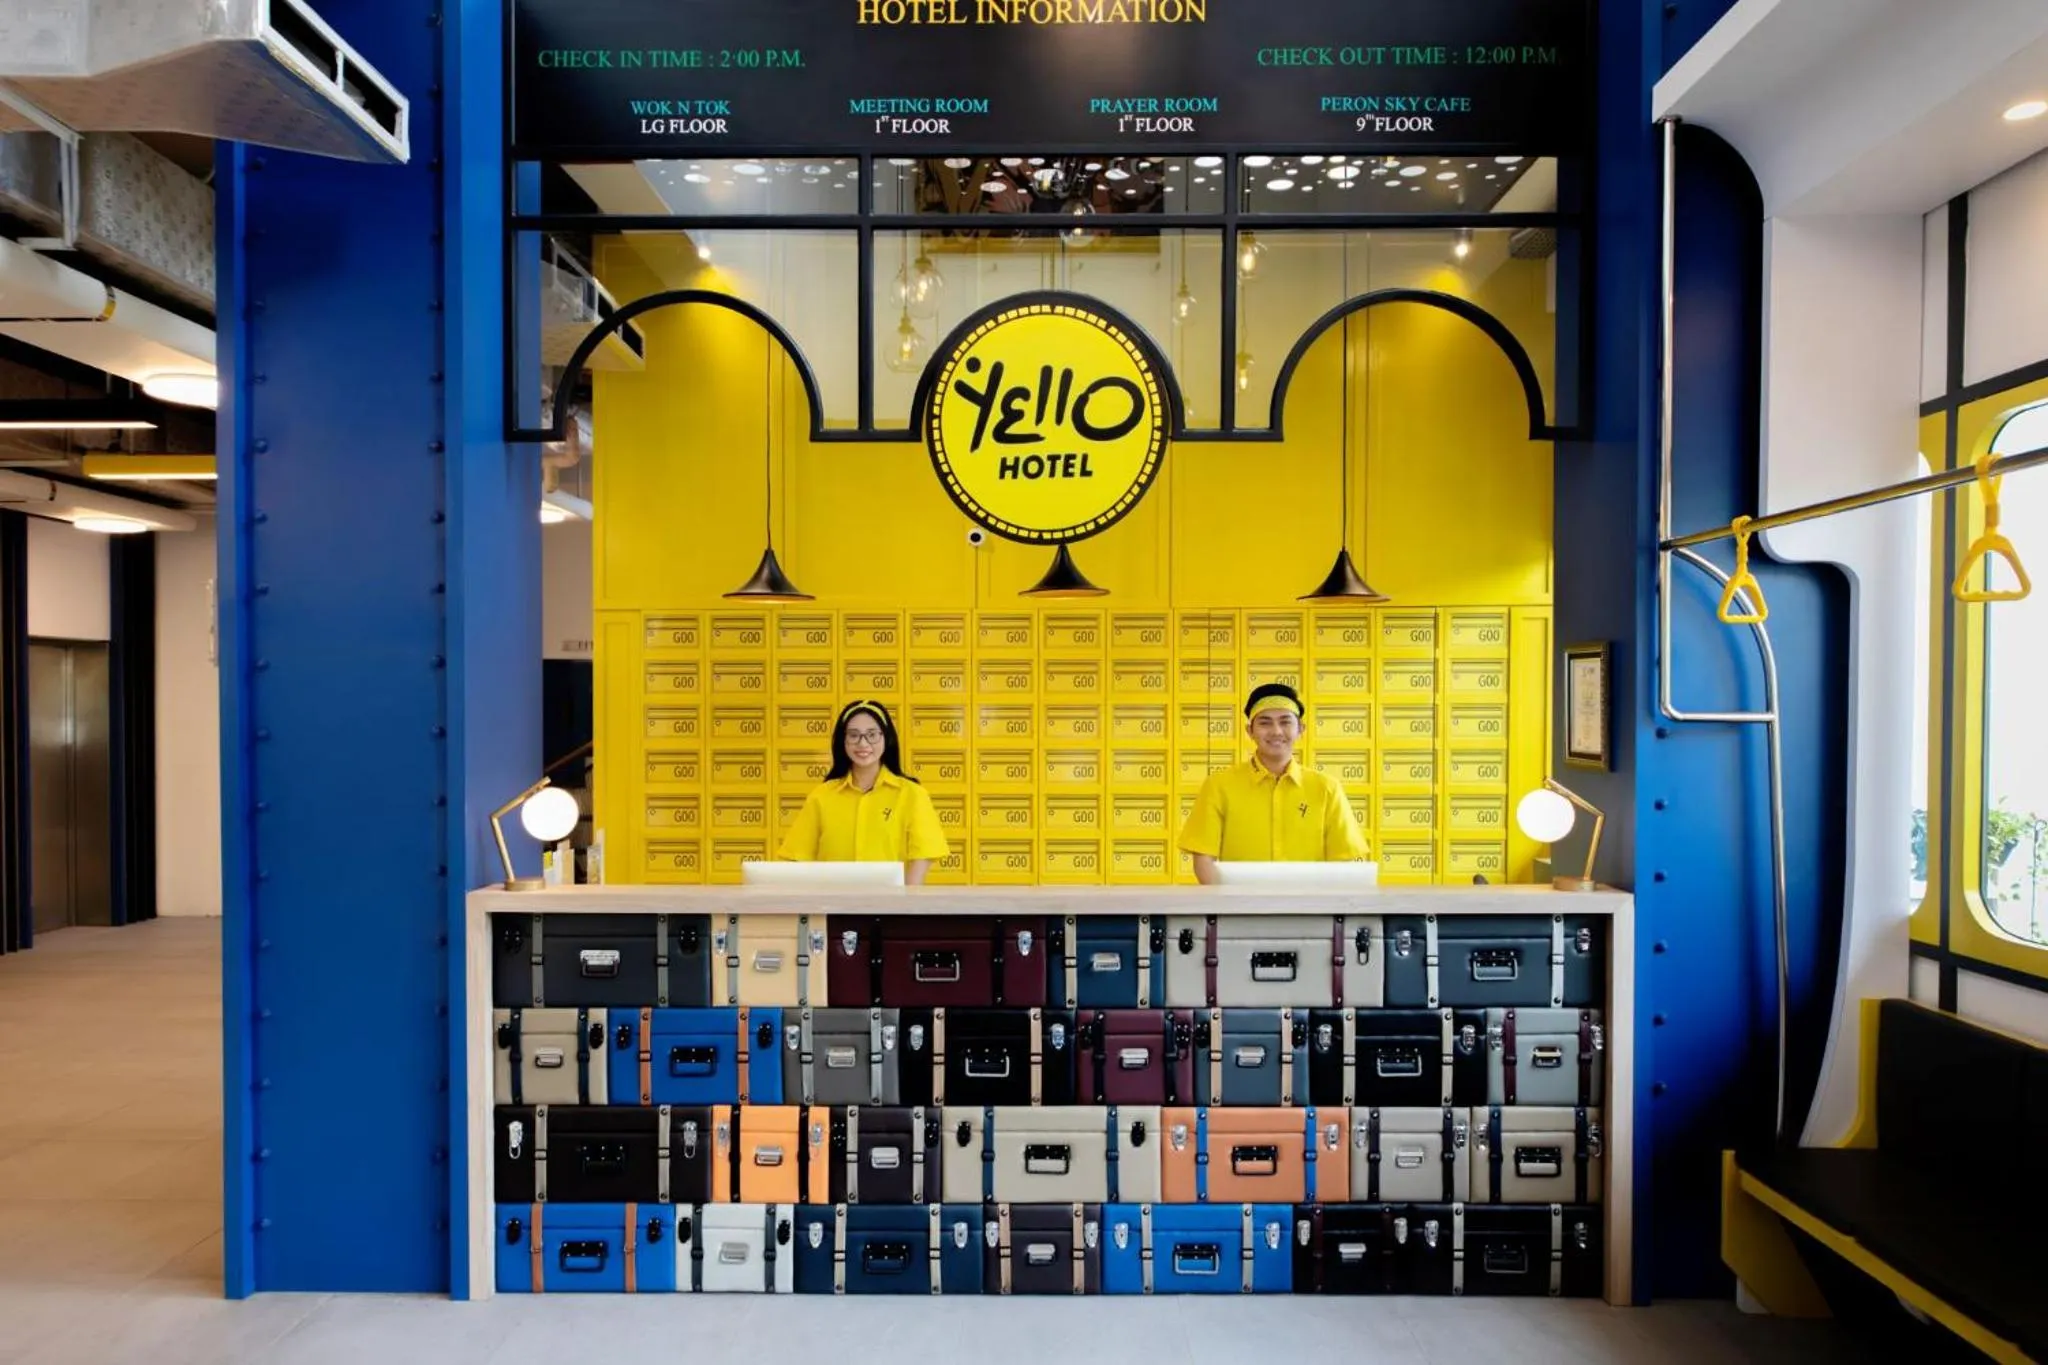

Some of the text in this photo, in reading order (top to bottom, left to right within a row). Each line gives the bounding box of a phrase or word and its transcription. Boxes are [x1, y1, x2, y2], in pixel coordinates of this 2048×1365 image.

[856, 0, 1206, 24] HOTEL INFORMATION
[537, 50, 614, 68] CHECK
[620, 50, 643, 68] IN
[647, 50, 702, 68] TIME
[765, 50, 806, 68] P.M.
[1256, 47, 1334, 66] CHECK
[1340, 46, 1388, 65] OUT
[1391, 46, 1448, 65] TIME
[1465, 45, 1516, 65] 12:00
[630, 100, 731, 115] WOK N TOK
[849, 98, 989, 113] MEETING ROOM
[1089, 97, 1219, 113] PRAYER ROOM
[1321, 97, 1472, 112] PERON SKY CAFE
[640, 118, 728, 133] LG FLOOR
[891, 118, 951, 133] FLOOR
[1135, 117, 1195, 132] FLOOR
[1375, 116, 1434, 132] FLOOR
[998, 453, 1093, 480] HOTEL
